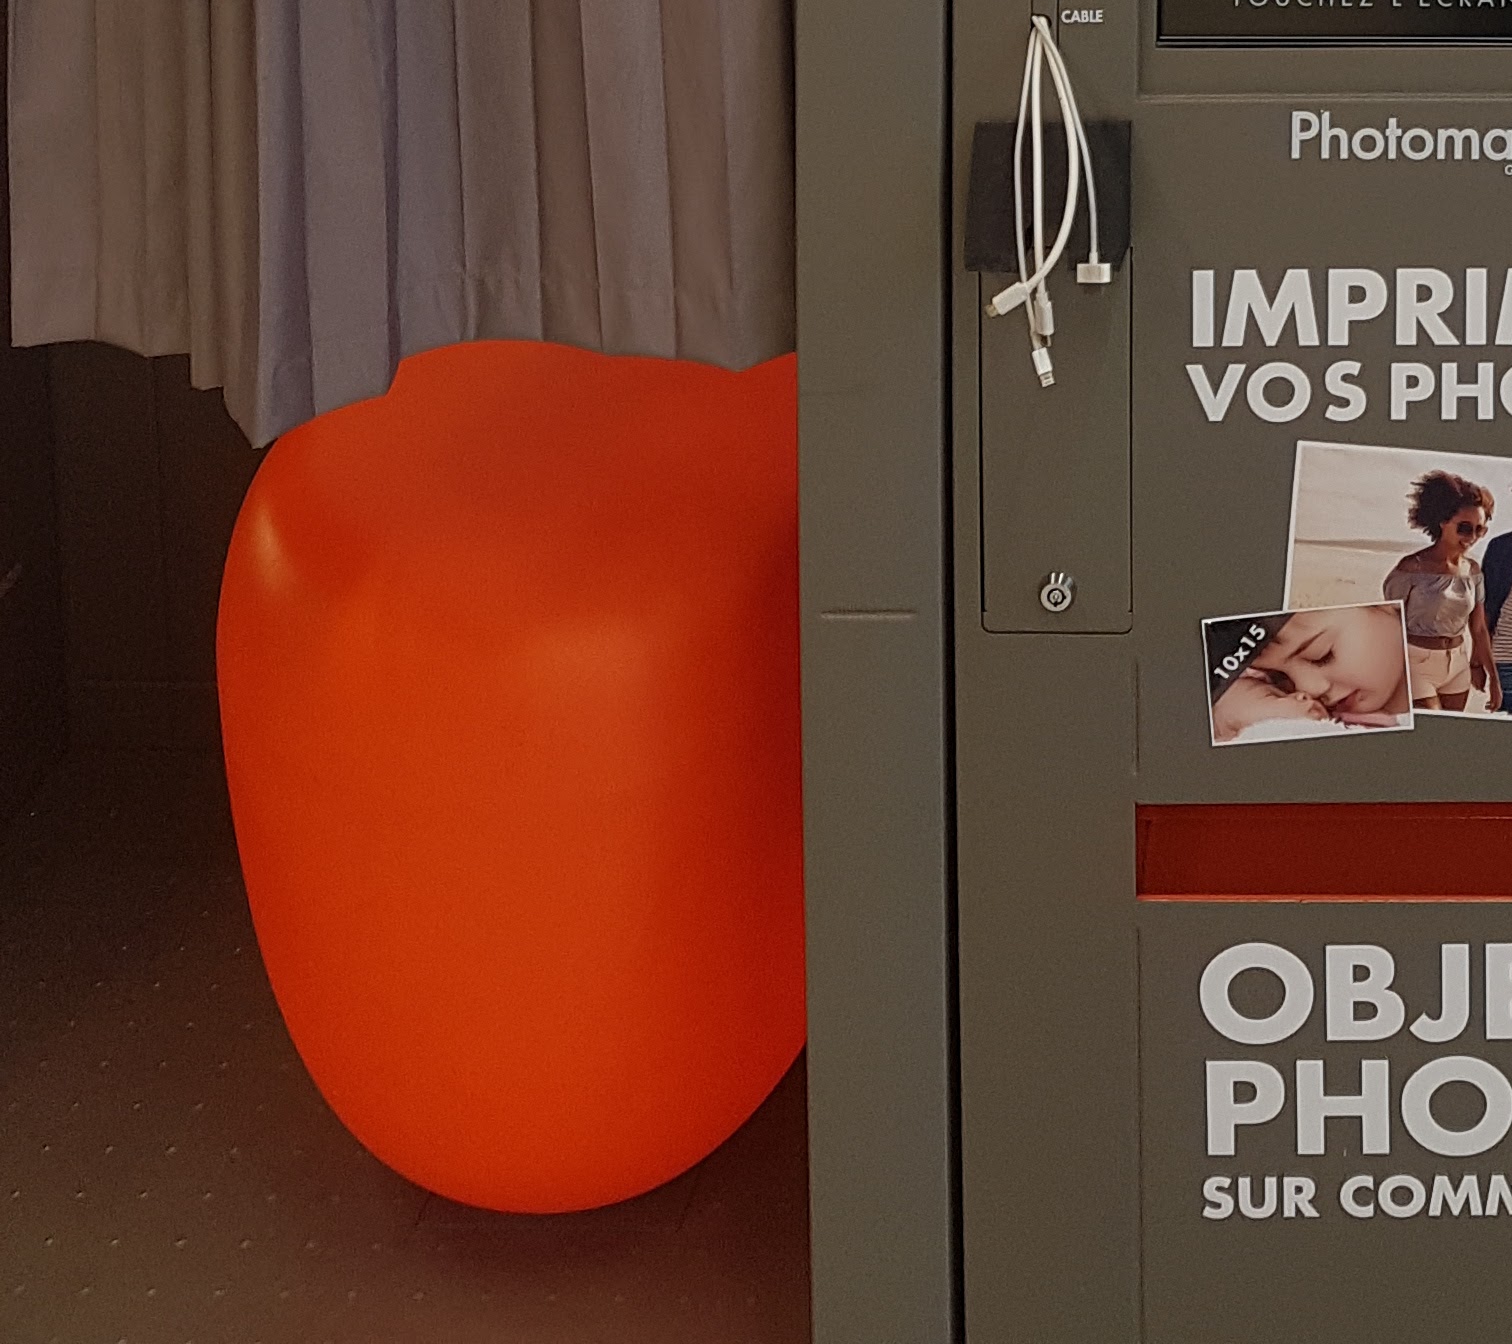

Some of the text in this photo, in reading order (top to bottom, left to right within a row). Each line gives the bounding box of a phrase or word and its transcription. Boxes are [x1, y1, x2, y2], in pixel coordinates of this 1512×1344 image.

[1061, 10, 1103, 23] CABLE
[1187, 361, 1366, 422] VOS
[1213, 624, 1265, 679] 10x15
[1203, 1175, 1319, 1219] SUR
